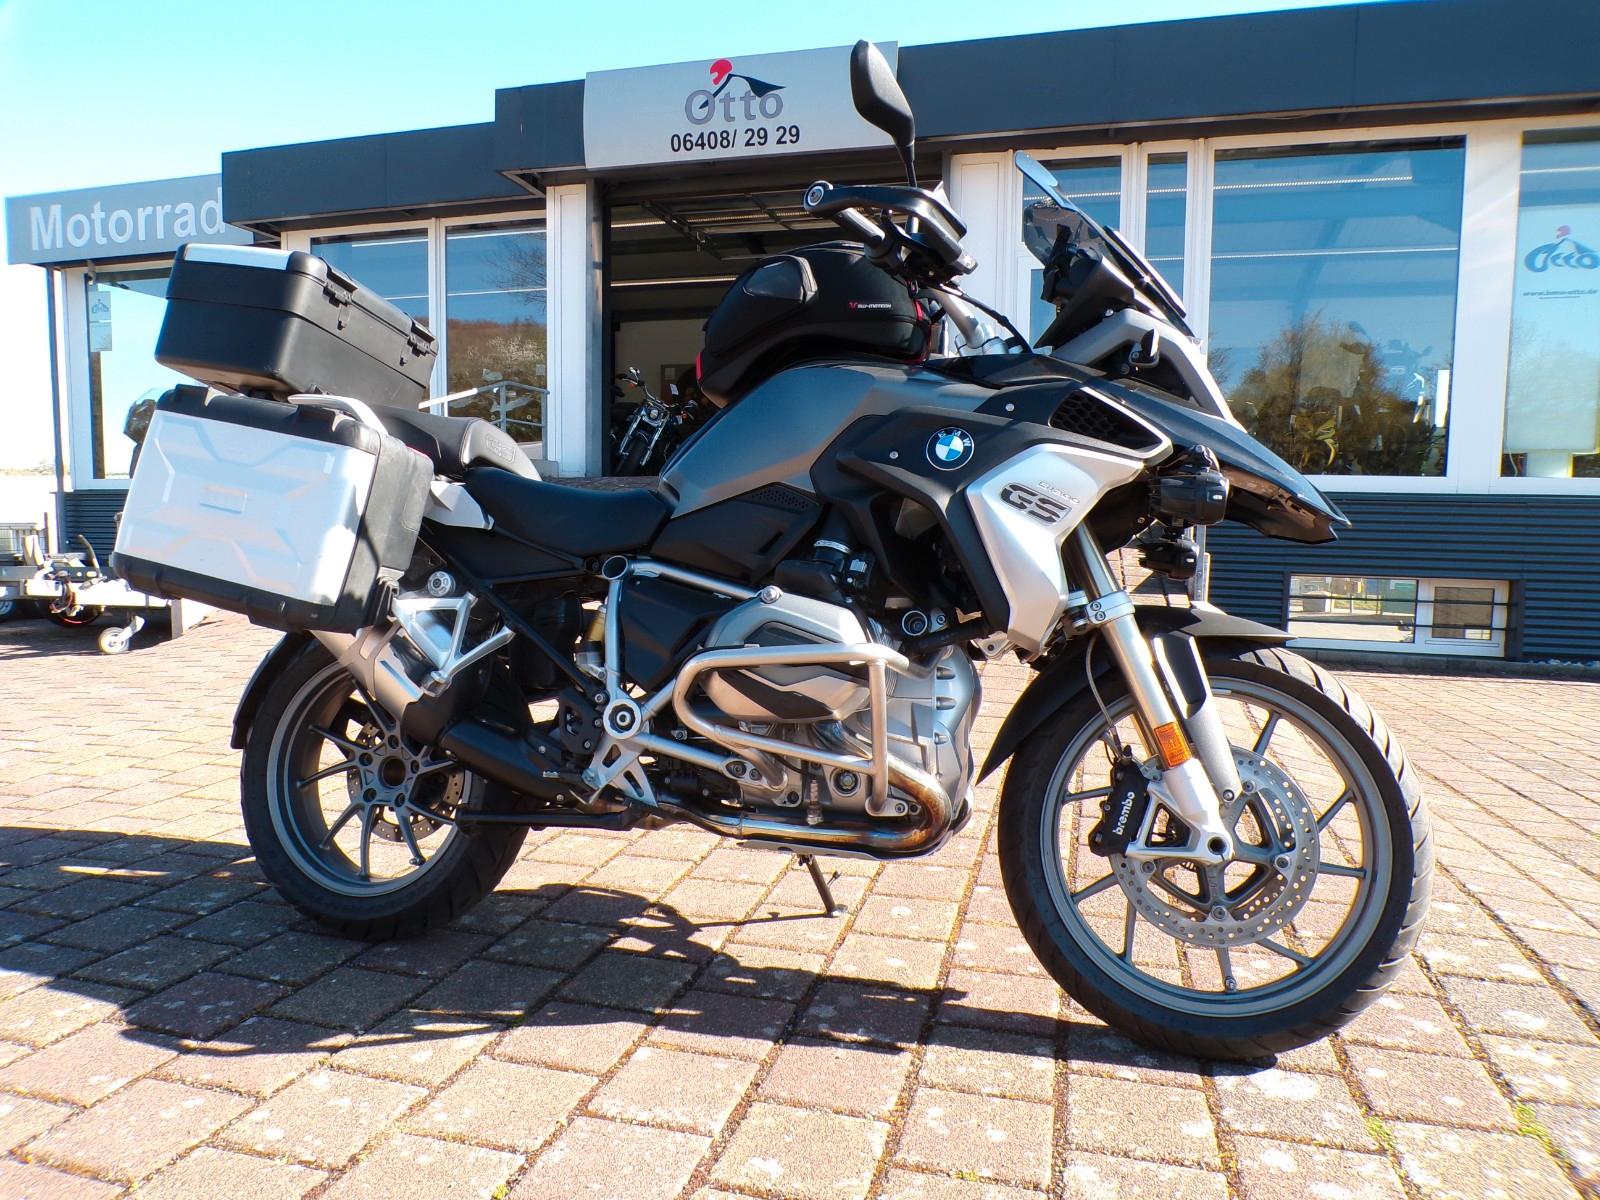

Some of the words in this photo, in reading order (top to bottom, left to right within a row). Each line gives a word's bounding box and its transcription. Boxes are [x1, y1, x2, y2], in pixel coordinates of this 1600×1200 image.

[685, 89, 784, 125] Otto
[670, 129, 737, 152] 06408/
[744, 127, 768, 147] 29
[775, 124, 800, 145] 29
[29, 187, 226, 251] Motorrad
[937, 430, 972, 447] BMW
[1000, 484, 1068, 523] GS
[1112, 791, 1136, 836] brembo
